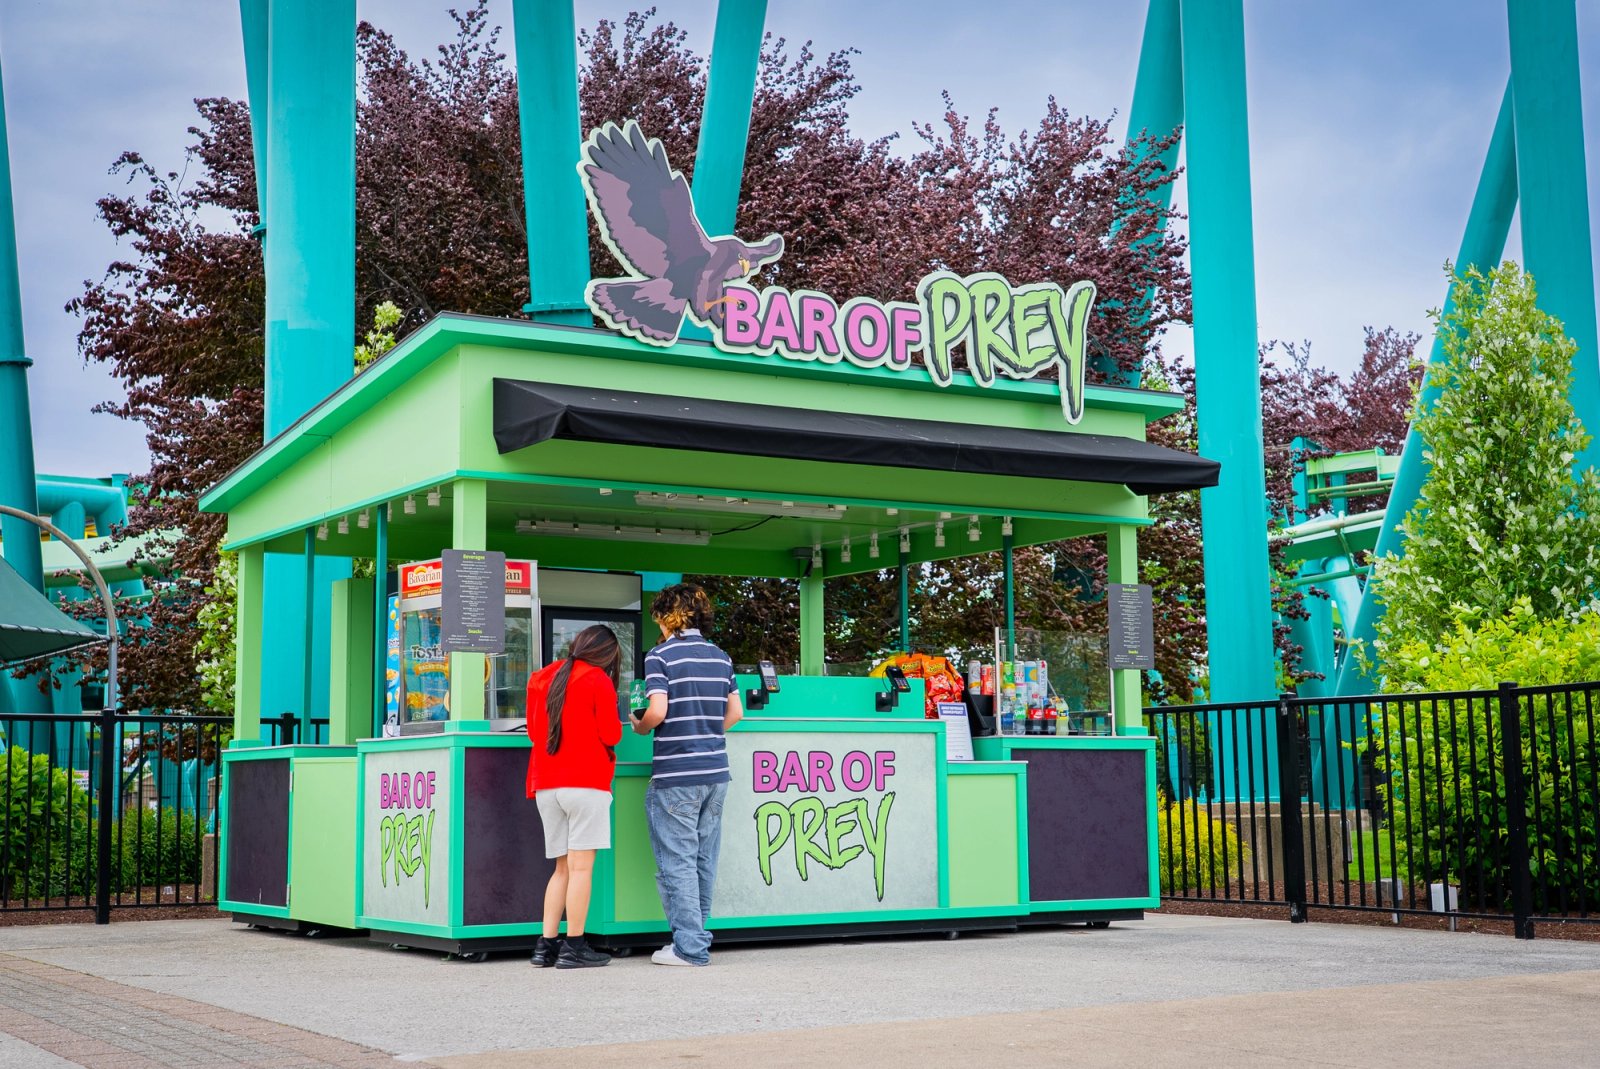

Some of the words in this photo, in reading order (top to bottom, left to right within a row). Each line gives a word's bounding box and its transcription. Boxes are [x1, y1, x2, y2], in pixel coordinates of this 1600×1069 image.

[724, 286, 840, 355] BAR
[843, 302, 922, 364] OF
[922, 276, 1094, 422] PREY
[408, 570, 441, 585] Bavarian
[380, 772, 411, 809] BAR
[413, 771, 436, 809] OF
[753, 750, 836, 793] BAR
[841, 750, 896, 792] OF
[380, 808, 436, 909] PREY
[753, 791, 896, 902] PREY
